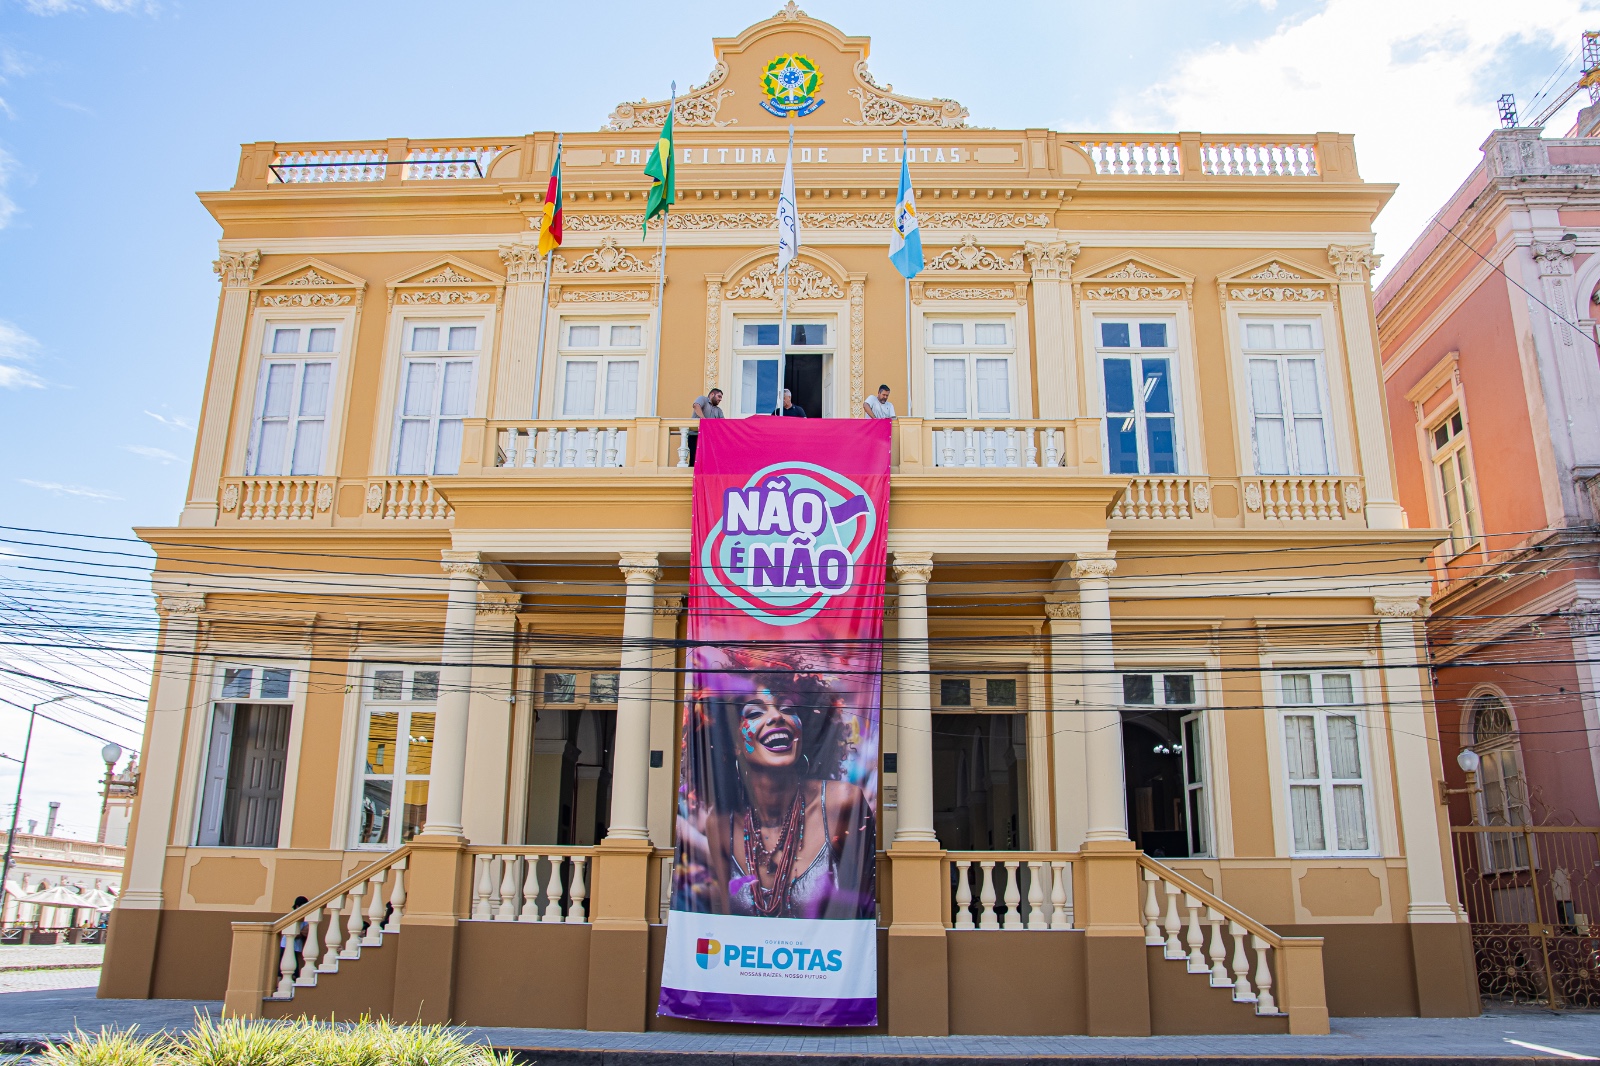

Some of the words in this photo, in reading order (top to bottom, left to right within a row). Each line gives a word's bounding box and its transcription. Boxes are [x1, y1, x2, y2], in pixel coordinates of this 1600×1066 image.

[615, 148, 776, 164] PREEITURA
[800, 147, 828, 163] DE
[862, 147, 960, 163] PELOTAS
[725, 479, 824, 534] NÃO
[729, 541, 745, 573] É
[752, 536, 848, 590] NÃO
[723, 944, 843, 972] PELOTAS
